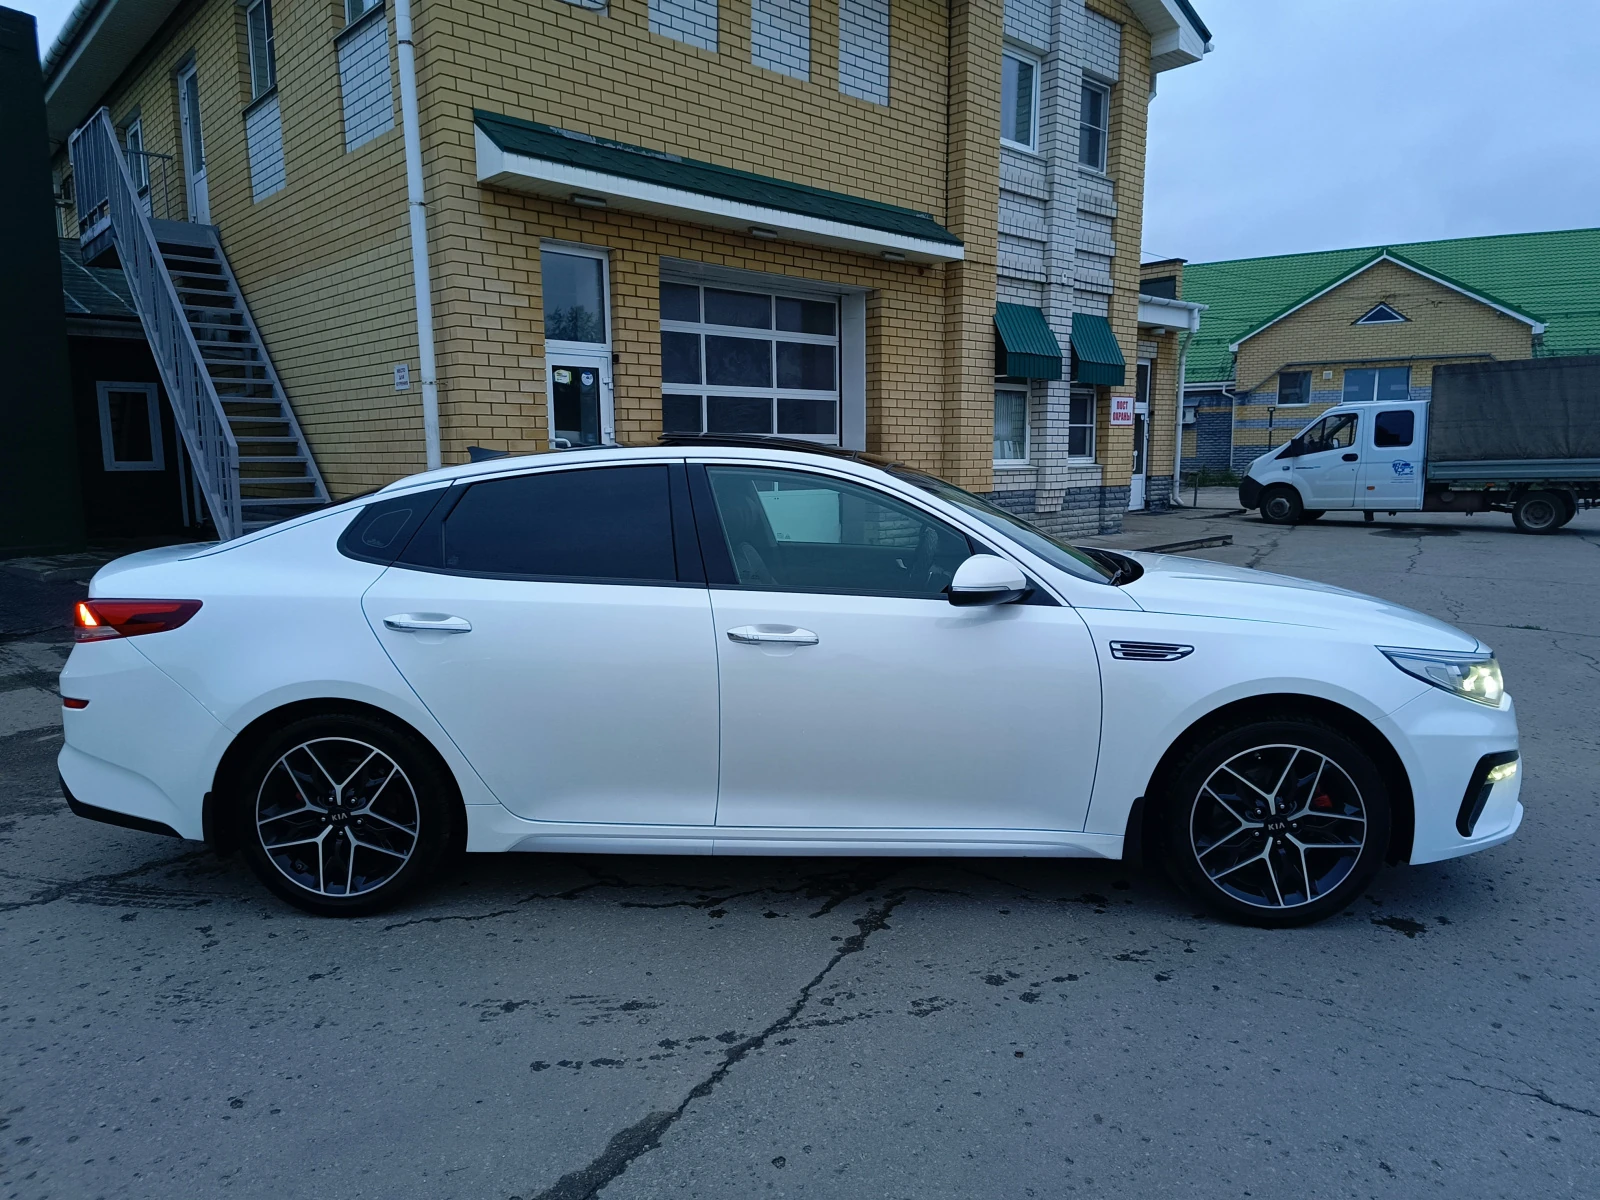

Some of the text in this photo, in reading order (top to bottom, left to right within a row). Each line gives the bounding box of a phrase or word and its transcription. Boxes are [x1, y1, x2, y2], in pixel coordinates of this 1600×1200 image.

[1116, 401, 1128, 410] ПОСТ
[1113, 412, 1131, 421] ОХРАНЫ
[331, 812, 348, 821] KIA
[1267, 822, 1285, 831] KIA
